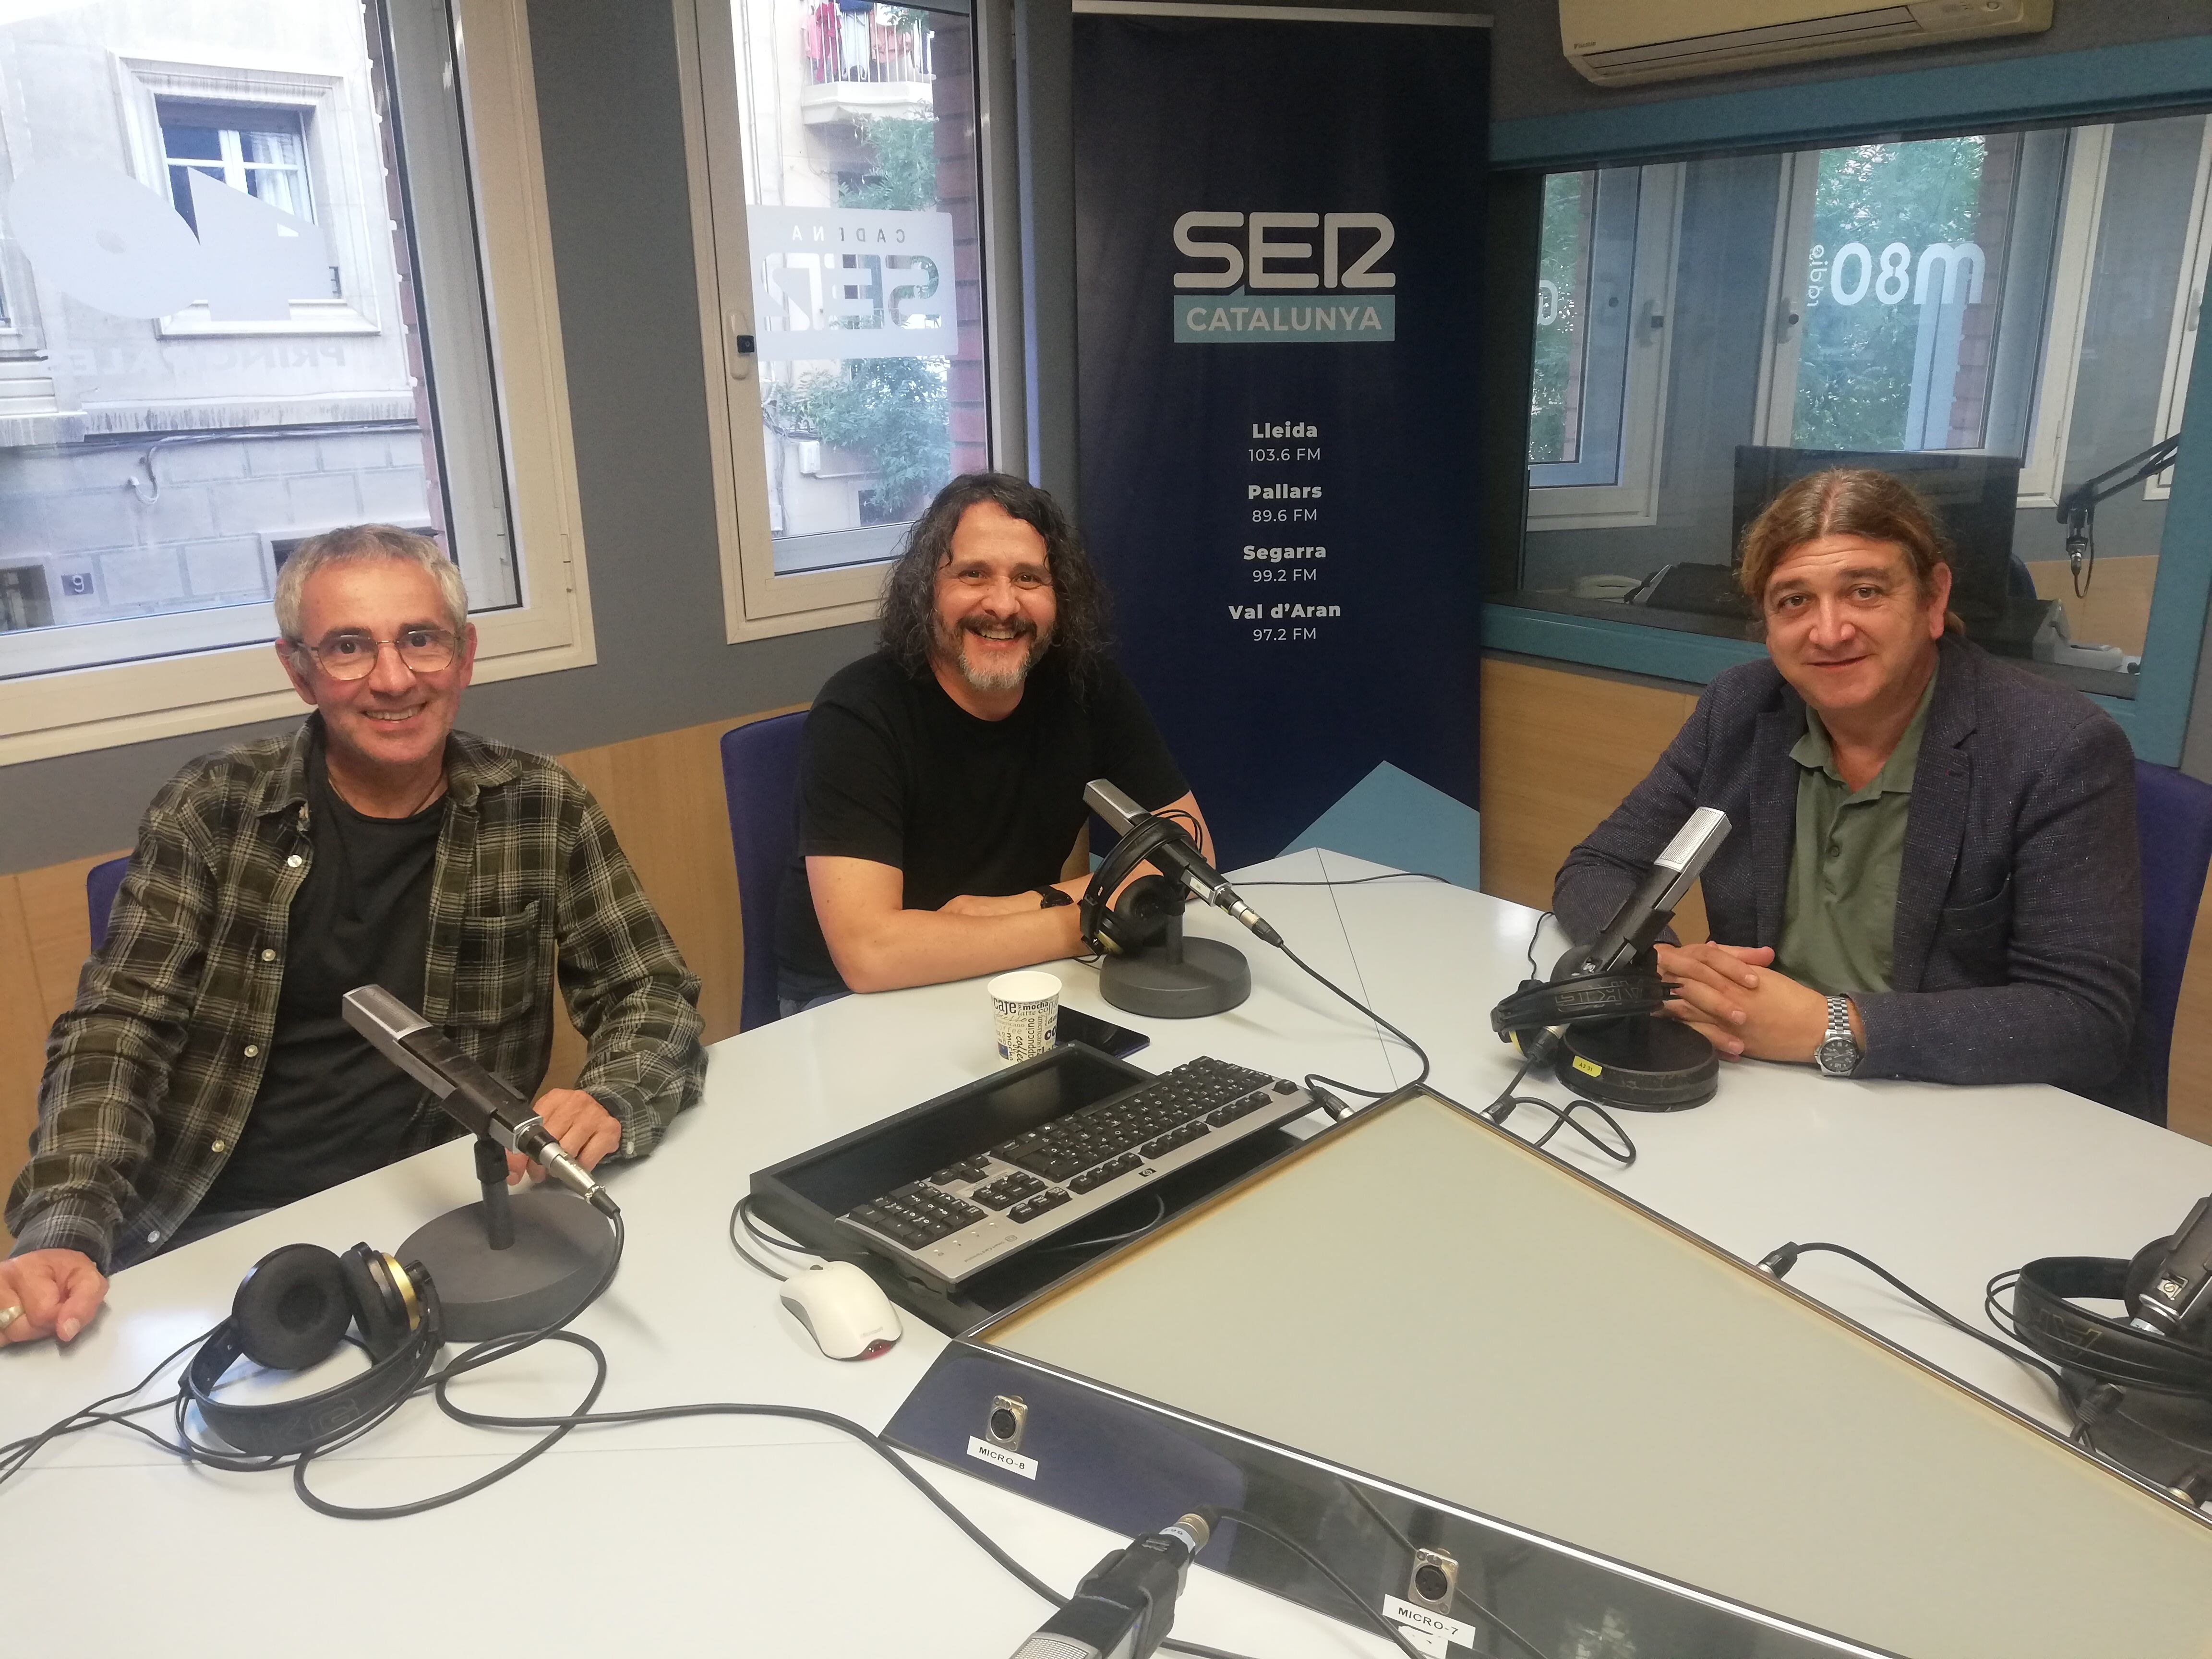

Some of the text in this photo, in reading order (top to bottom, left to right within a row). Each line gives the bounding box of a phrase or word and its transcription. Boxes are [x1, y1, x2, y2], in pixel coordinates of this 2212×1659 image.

[1173, 211, 1396, 288] SER
[1187, 307, 1382, 332] CATALUNYA
[1252, 421, 1318, 439] Lleida
[1248, 448, 1321, 461] 103.6 FM
[1248, 483, 1322, 499] Pallars
[1252, 509, 1318, 523] 89.6 FM
[1243, 544, 1326, 563] Segarra
[72, 575, 85, 593] 9
[1252, 569, 1317, 582] 99.2 FM
[1228, 604, 1263, 620] Val
[1253, 627, 1316, 641] 97.2 FM
[1023, 1002, 1048, 1010] mocha
[1007, 1033, 1015, 1061] mocha
[1026, 1018, 1037, 1058] appuccino
[979, 1446, 1025, 1469] MICRO-8
[1398, 1607, 1459, 1635] MICRO-7
